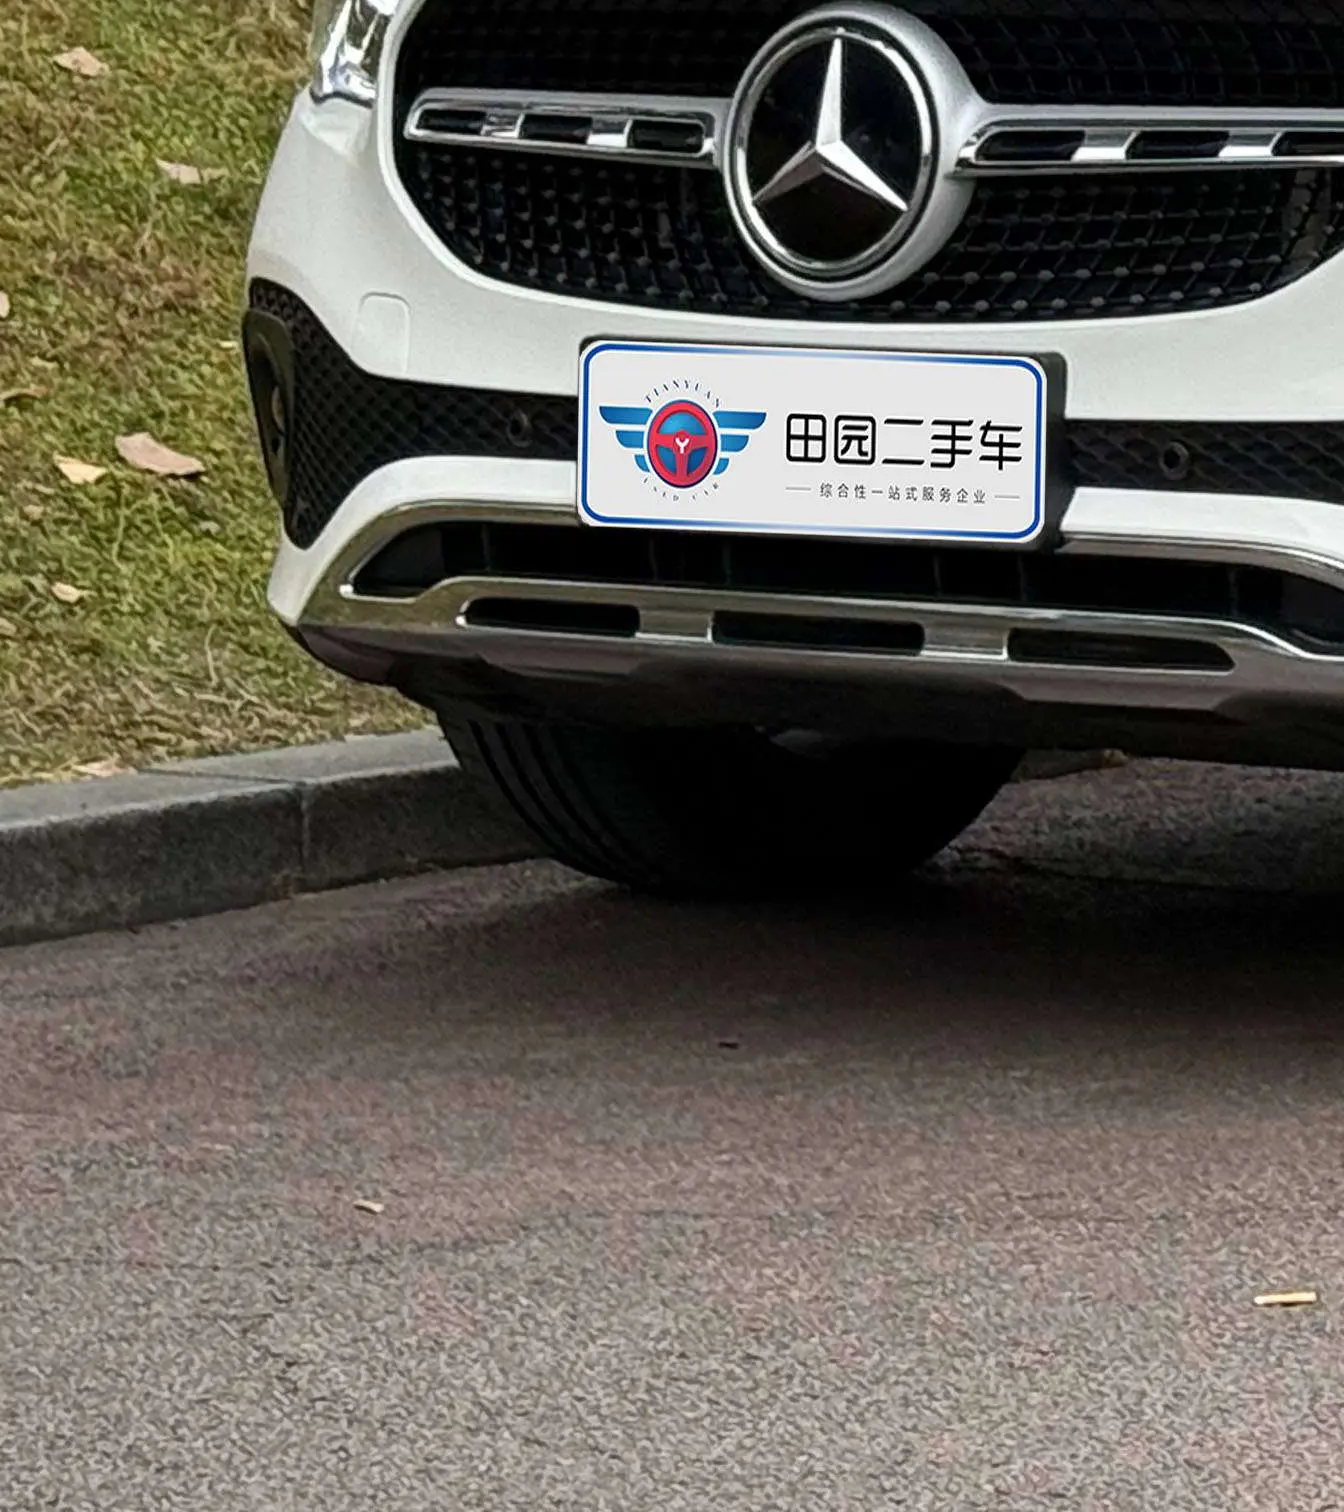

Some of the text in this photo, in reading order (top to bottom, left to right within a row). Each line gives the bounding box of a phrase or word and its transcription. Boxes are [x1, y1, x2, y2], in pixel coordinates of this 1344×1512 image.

[786, 413, 1023, 471] 田园二手车
[819, 482, 987, 504] 综合性一站式服务企业
